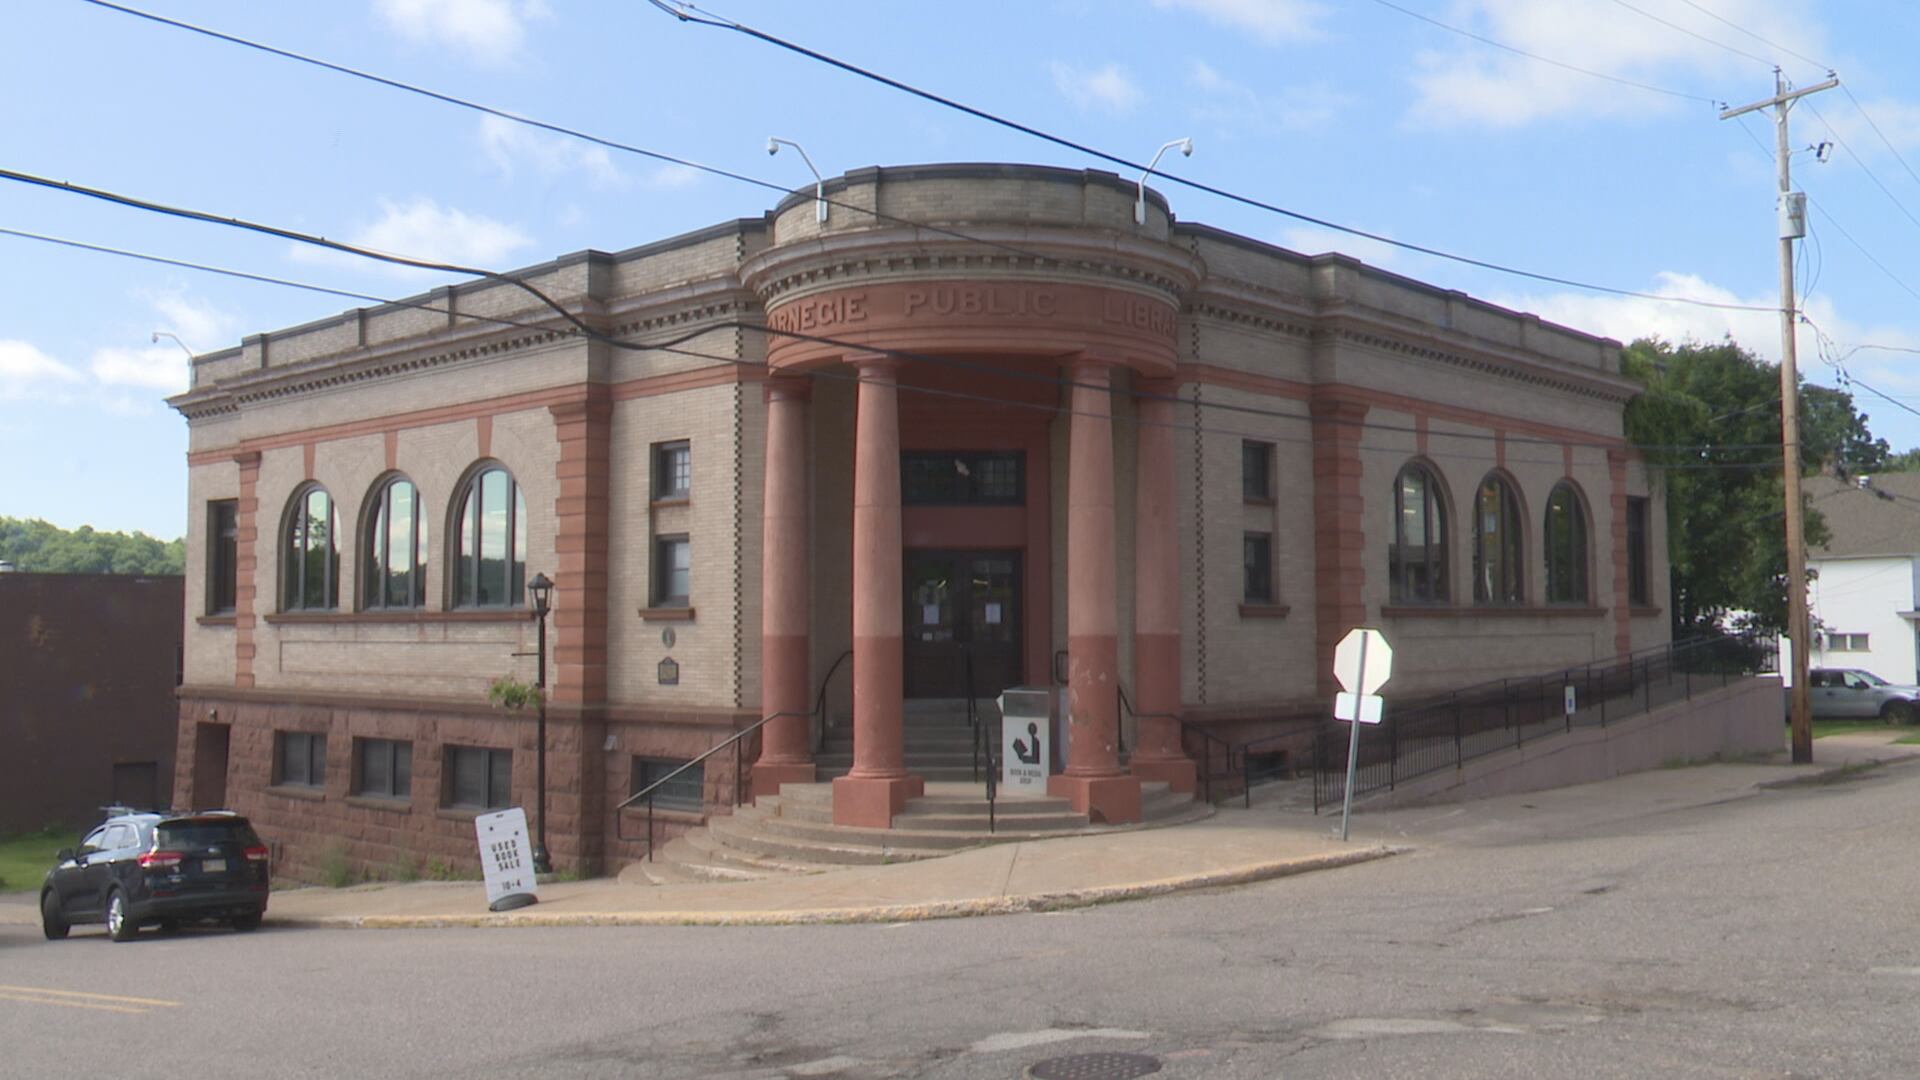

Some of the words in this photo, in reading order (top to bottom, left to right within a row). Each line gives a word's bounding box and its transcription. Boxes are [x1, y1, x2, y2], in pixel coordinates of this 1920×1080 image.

[768, 293, 867, 341] ARNEGIE
[903, 287, 1057, 317] PUBLIC
[1103, 294, 1176, 337] LIBRA
[491, 839, 517, 852] USED
[495, 850, 518, 862] BOOK
[498, 858, 520, 872] SALE
